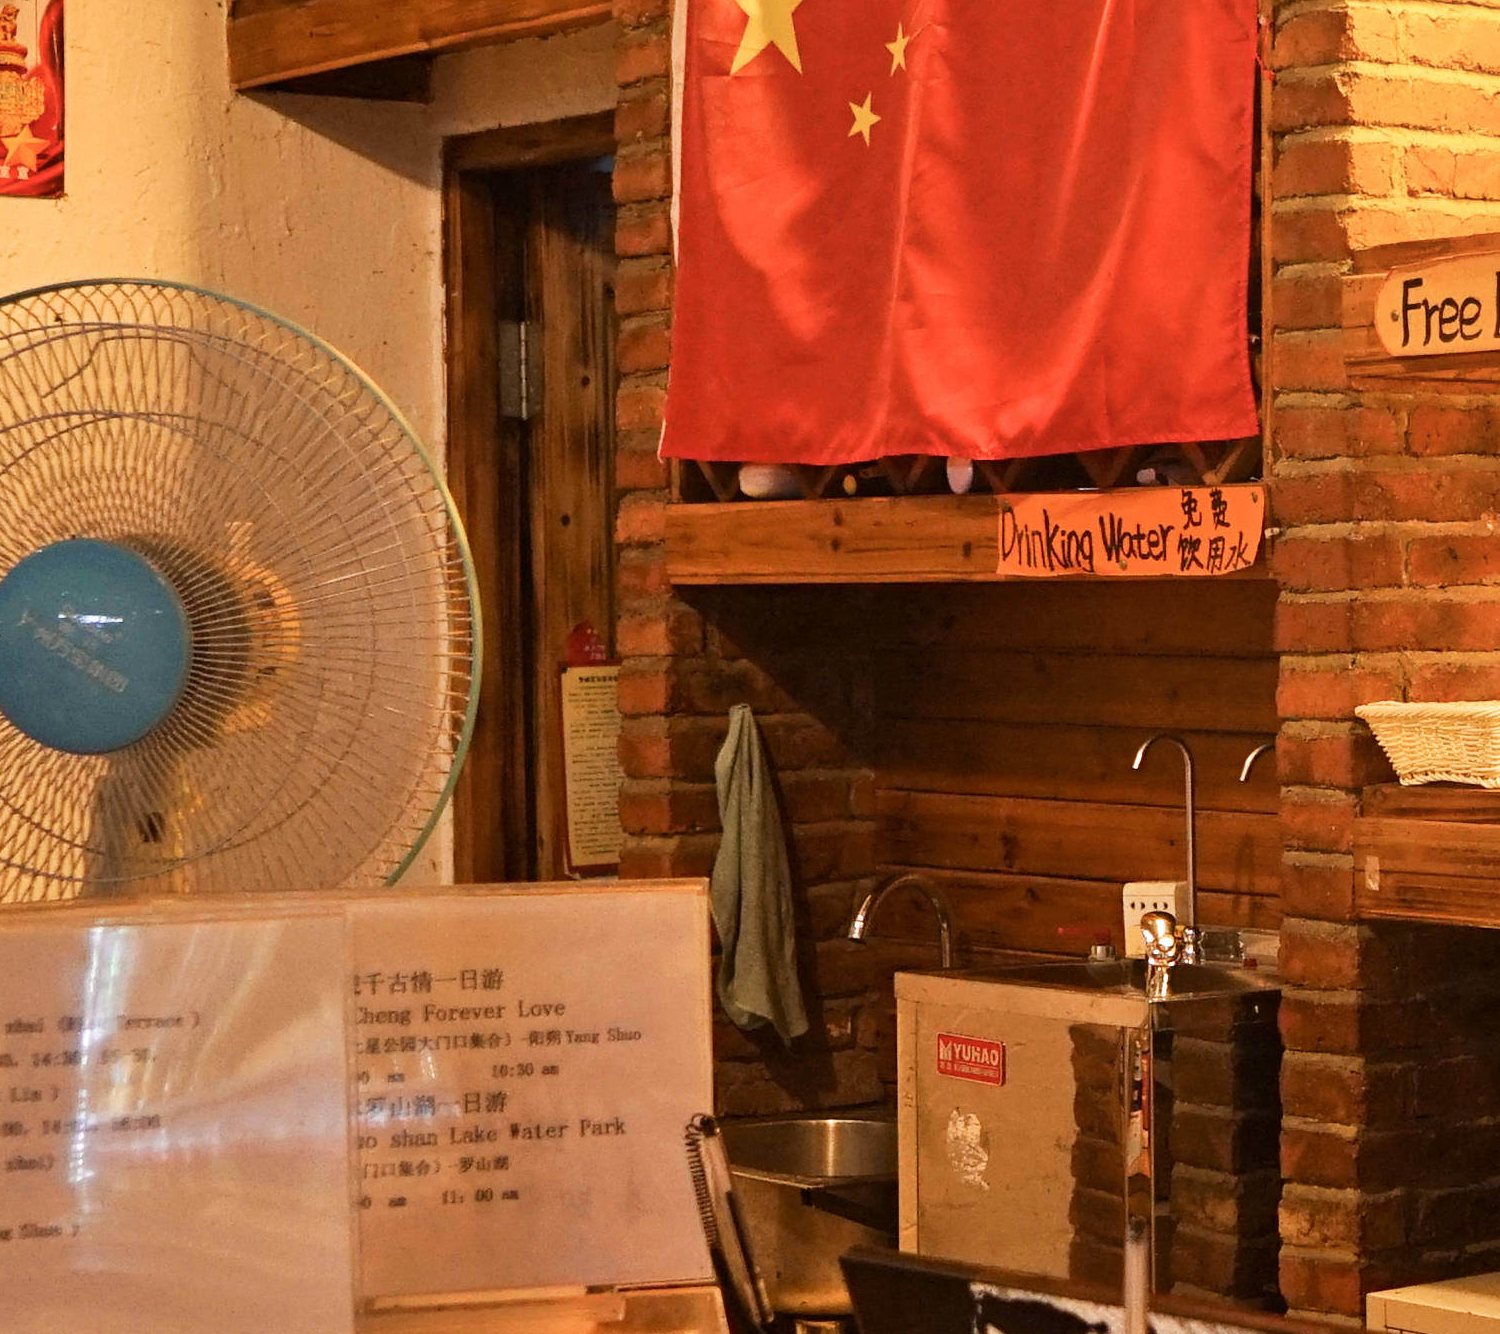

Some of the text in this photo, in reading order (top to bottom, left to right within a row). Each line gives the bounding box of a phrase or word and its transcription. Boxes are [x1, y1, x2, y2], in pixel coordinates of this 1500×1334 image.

[1401, 278, 1483, 347] Free
[1181, 489, 1230, 529] 免费
[1002, 507, 1174, 573] Drinking Water
[1178, 531, 1252, 573] 饮用水
[423, 1003, 506, 1022] Forever
[518, 1000, 566, 1019] Love
[606, 1027, 642, 1043] Shuo
[390, 1117, 627, 1149] shan Lake Water Park
